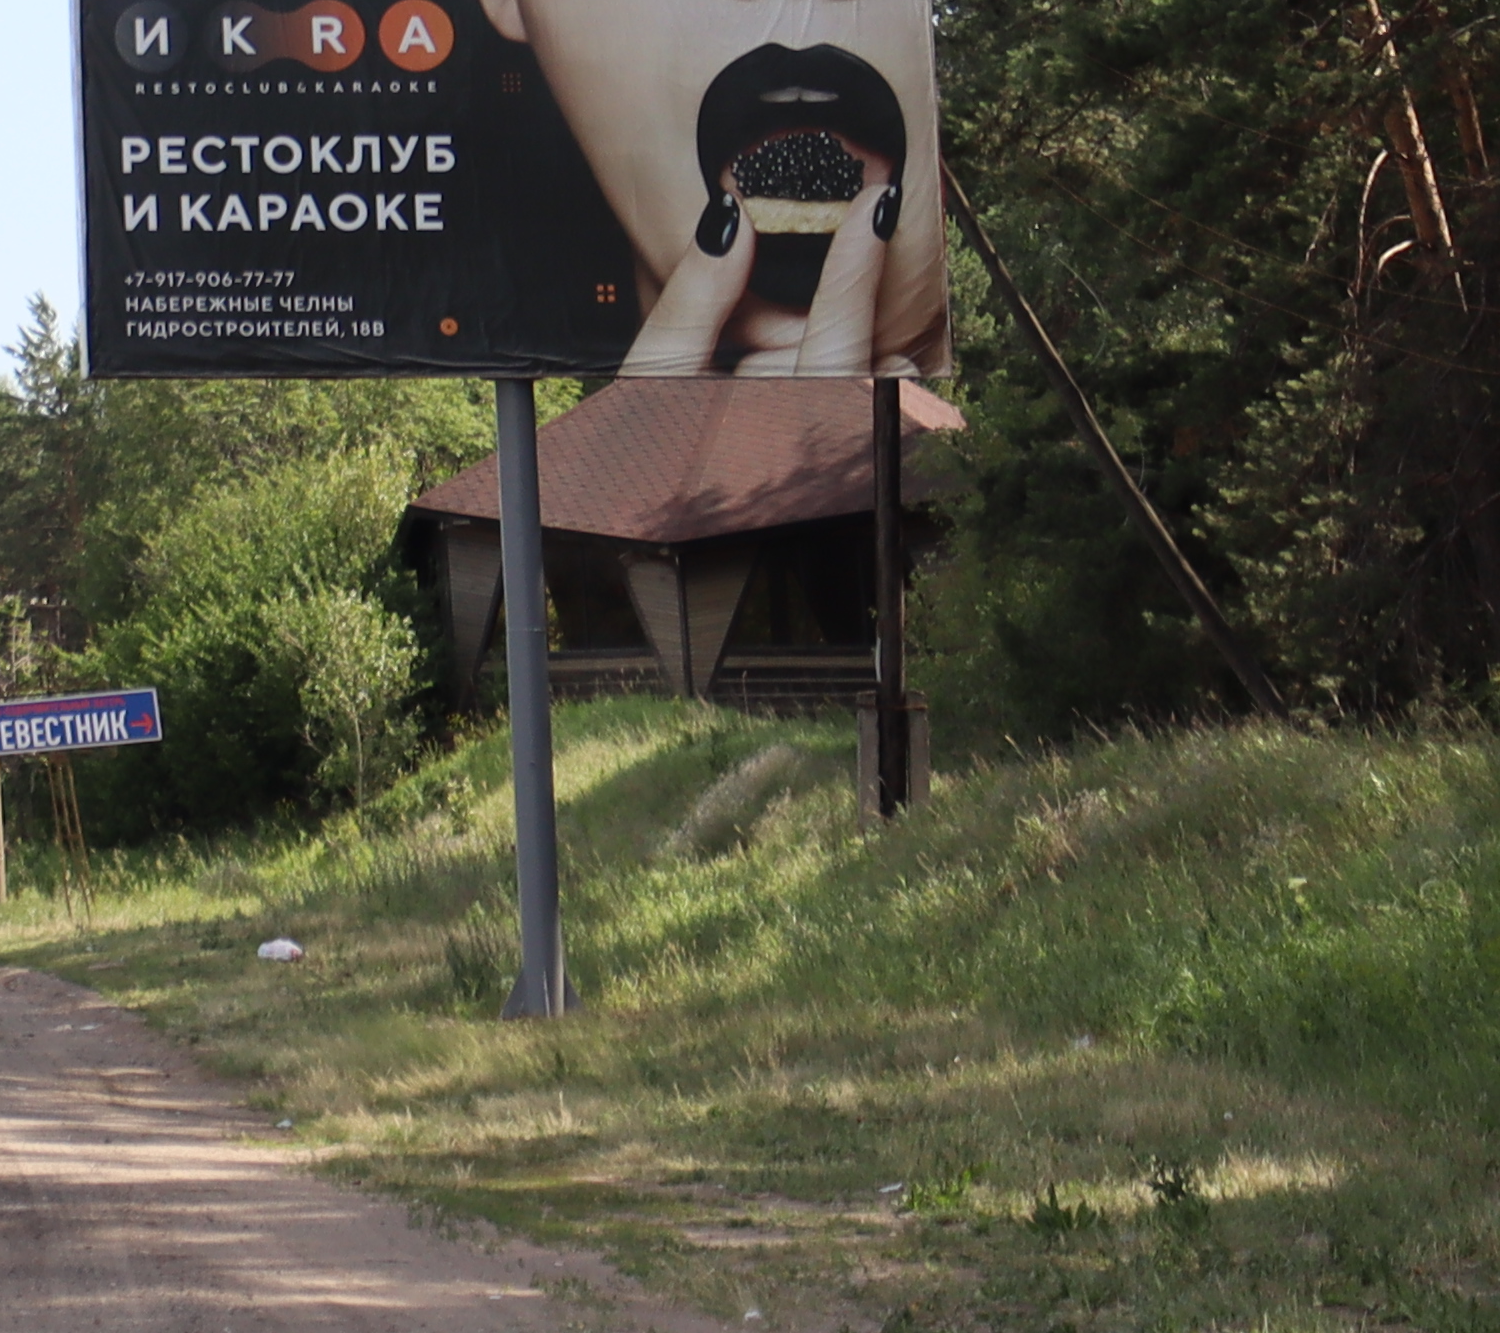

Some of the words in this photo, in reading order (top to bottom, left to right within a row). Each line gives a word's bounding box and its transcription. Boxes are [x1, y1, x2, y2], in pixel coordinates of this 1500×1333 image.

[121, 134, 456, 175] РЕСТОКЛУБ
[123, 194, 158, 232] И
[180, 192, 445, 232] КАРАОКЕ
[124, 270, 295, 288] +7-917-906-77-77
[125, 295, 274, 312] НАБЕРЕЖНЫЕ
[279, 295, 354, 312] ЧЕЛНЫ
[126, 317, 345, 339] ГИДРОСТРОИТЕЛЕЙ,
